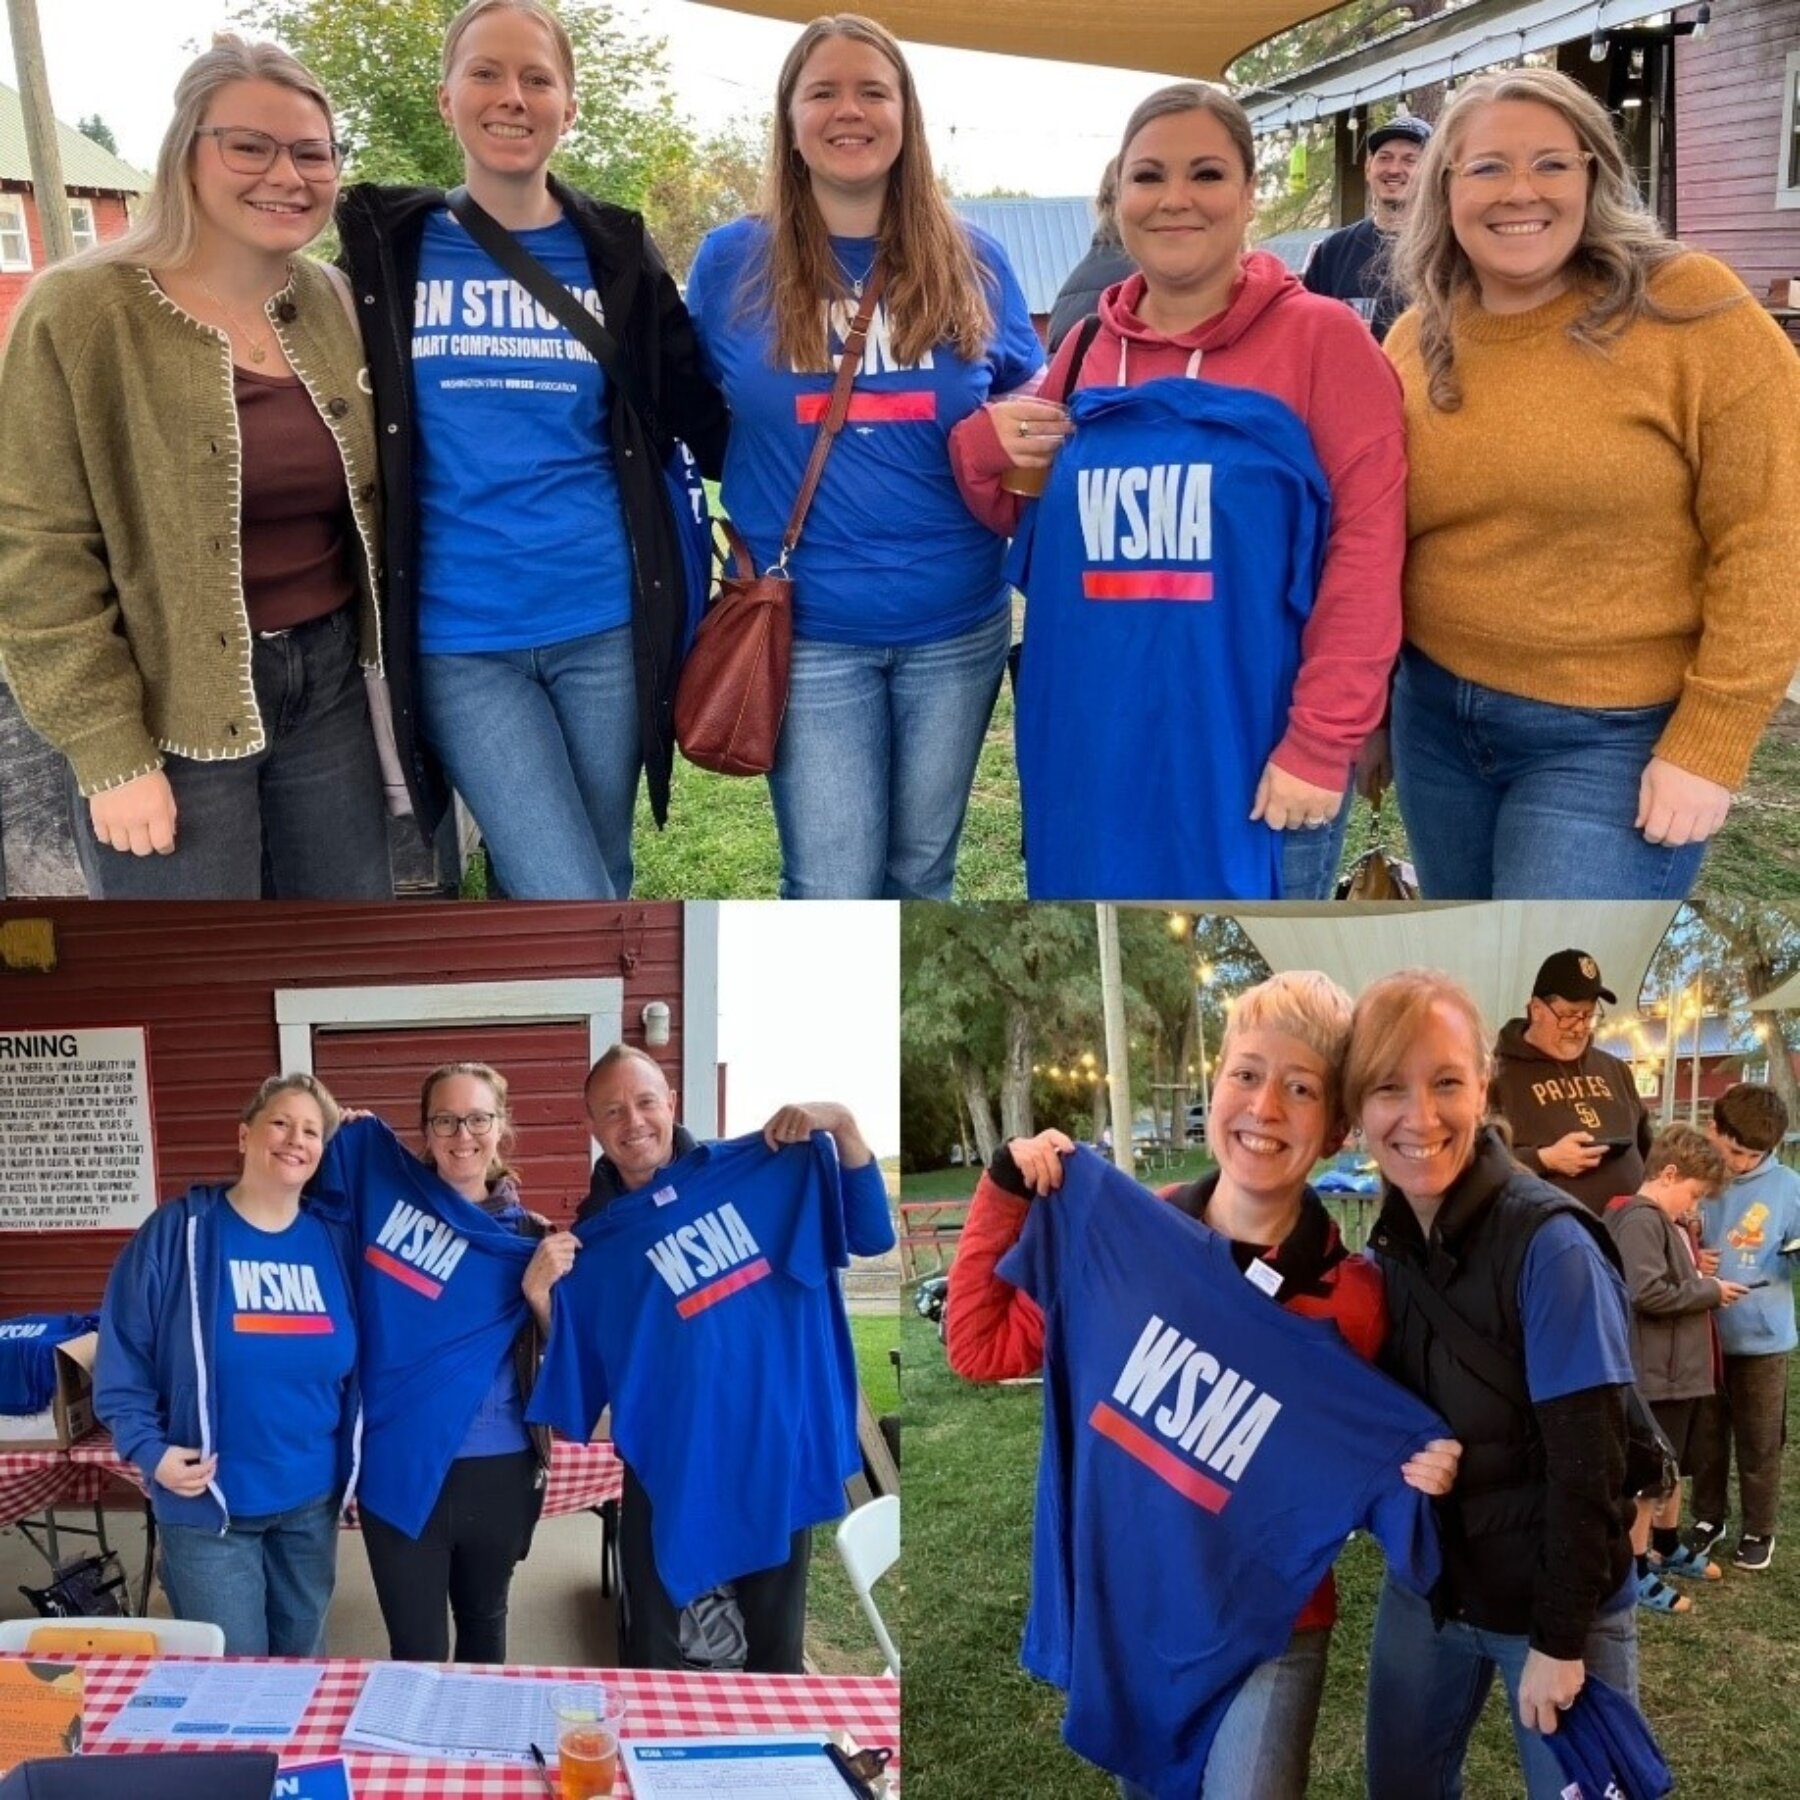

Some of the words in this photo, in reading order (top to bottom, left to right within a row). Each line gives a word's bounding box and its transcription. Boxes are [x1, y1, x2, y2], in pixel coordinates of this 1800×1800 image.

[450, 335, 563, 360] COMPASSIONATE
[1078, 464, 1213, 561] WSNA
[376, 1199, 469, 1281] WSNA
[644, 1202, 760, 1296] WSNA
[229, 1260, 327, 1312] WSNA
[1111, 1314, 1282, 1482] WSNA
